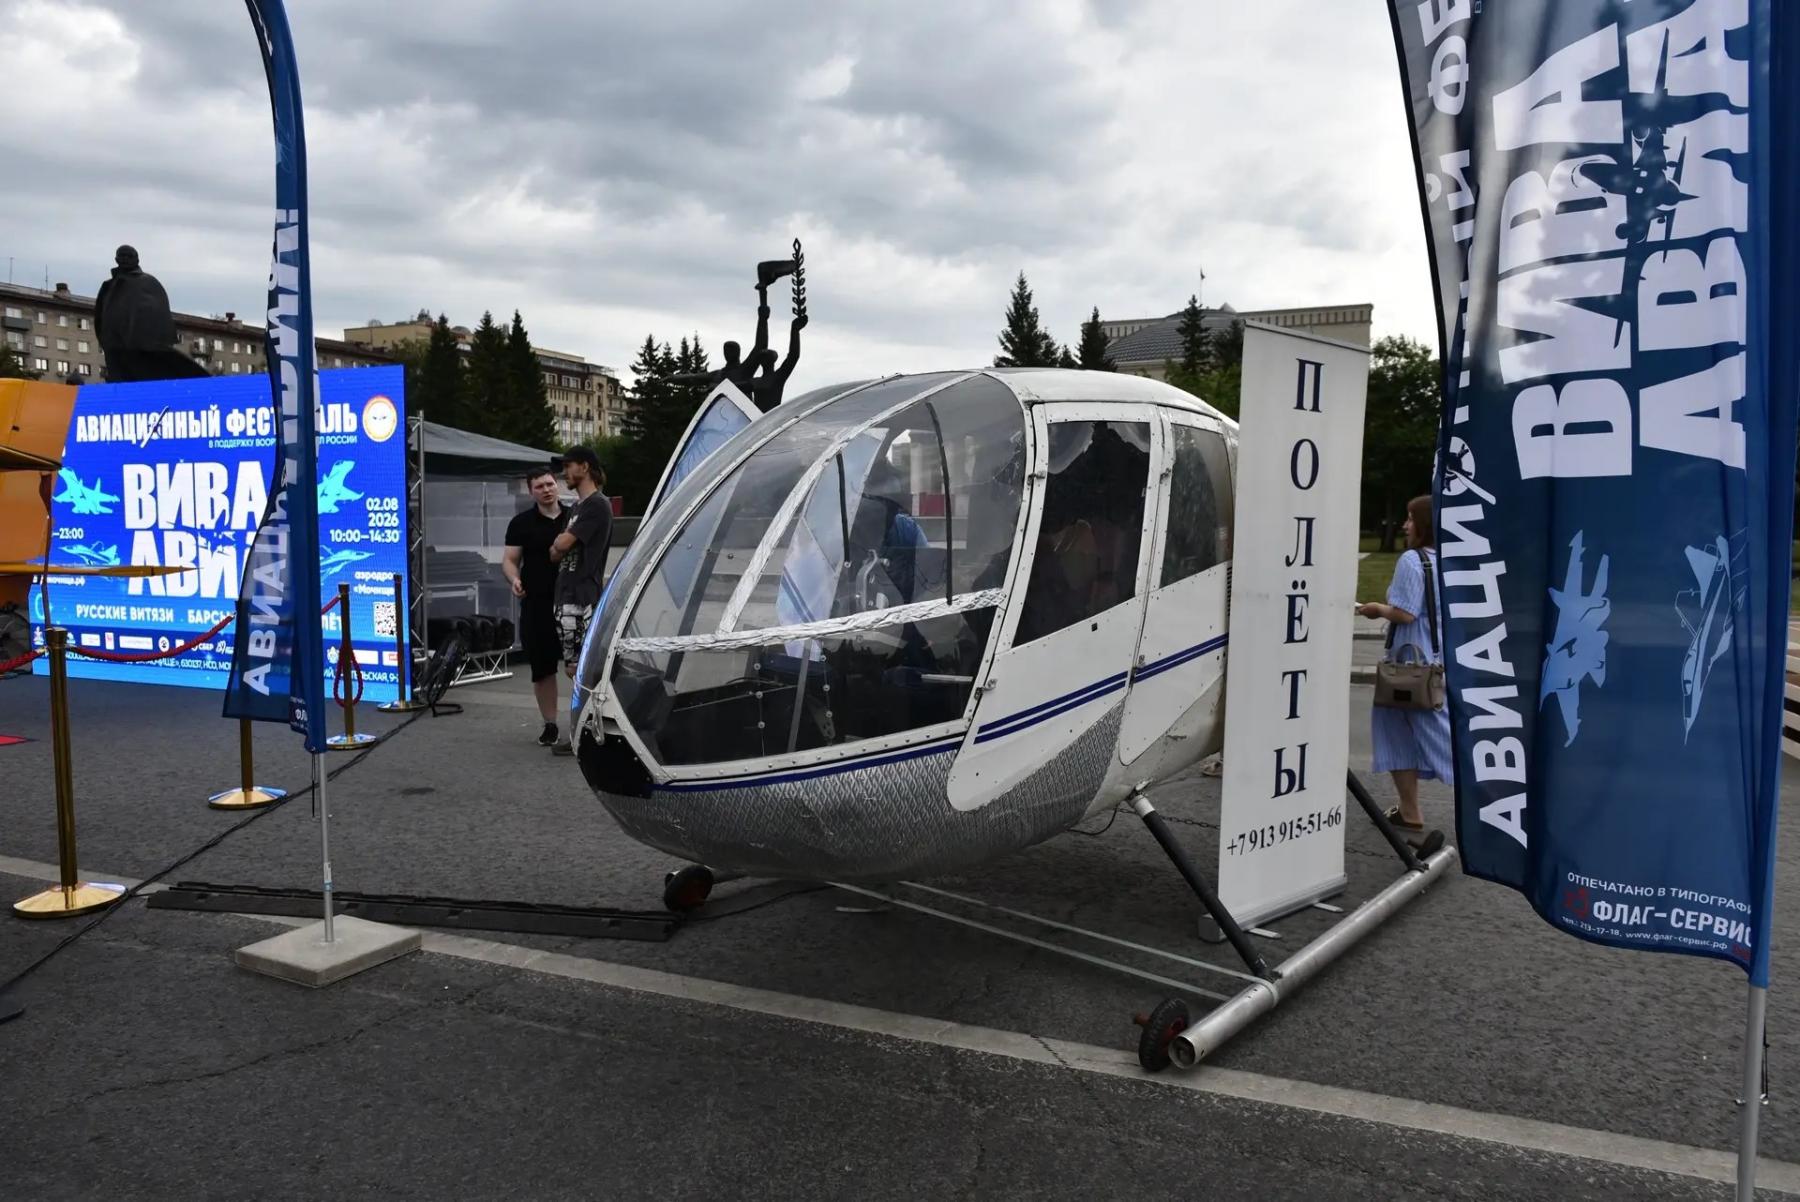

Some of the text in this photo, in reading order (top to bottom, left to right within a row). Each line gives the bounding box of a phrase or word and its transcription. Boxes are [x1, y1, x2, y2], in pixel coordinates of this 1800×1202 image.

[1493, 22, 1632, 480] ВИВА
[1626, 0, 1750, 470] АВИА
[76, 404, 221, 445] АВИАЦИОННЫЙ
[214, 438, 255, 449] ПОДДЕРЖКУ
[326, 435, 358, 444] РОССИИ
[123, 461, 269, 530] ВИВА
[366, 497, 399, 511] 02.08
[368, 512, 400, 527] 2026
[128, 530, 257, 599] АВИ
[354, 571, 395, 583] аэродро
[1269, 357, 1325, 799] ПОЛЁТЫ
[76, 604, 174, 623] РУССКИЕ ВИТЯЗИ
[1227, 804, 1342, 856] +7 913 915-51-66
[1567, 872, 1654, 897] ОТПЕЧАТАНО
[1657, 887, 1666, 897] В
[1625, 932, 1728, 951] www.флаг-сервис.рф
